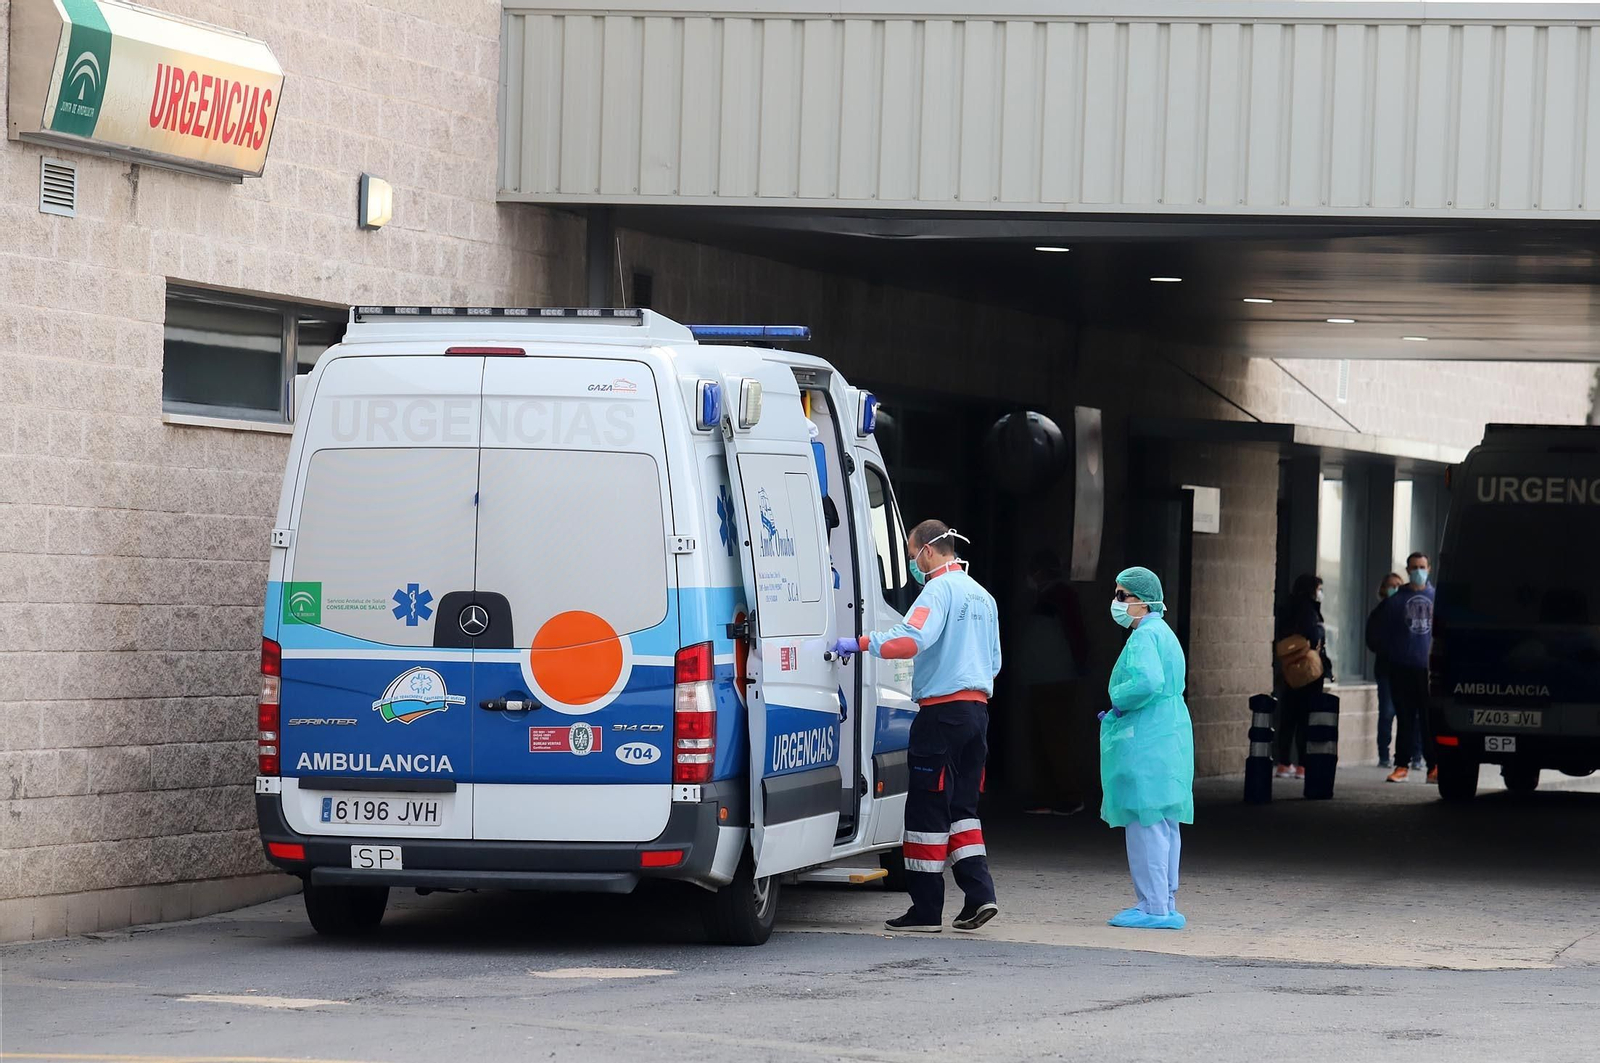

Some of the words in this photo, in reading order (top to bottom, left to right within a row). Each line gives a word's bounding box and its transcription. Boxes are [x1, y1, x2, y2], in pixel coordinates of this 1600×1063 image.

[149, 62, 273, 151] URGENCIAS
[587, 384, 613, 392] GAZA
[331, 399, 636, 447] URGENCIAS
[1453, 682, 1550, 697] AMBULANCIA
[288, 718, 358, 726] SPRINTER
[1476, 711, 1510, 725] 7403
[1514, 712, 1538, 726] JVL
[640, 724, 664, 732] CDI
[772, 725, 834, 772] URGENCIAS
[1488, 737, 1513, 751] SP
[623, 747, 652, 760] 704
[296, 752, 453, 773] AMBULANCIA
[336, 800, 389, 820] 6196
[397, 802, 437, 822] JVH
[358, 848, 394, 868] SP
